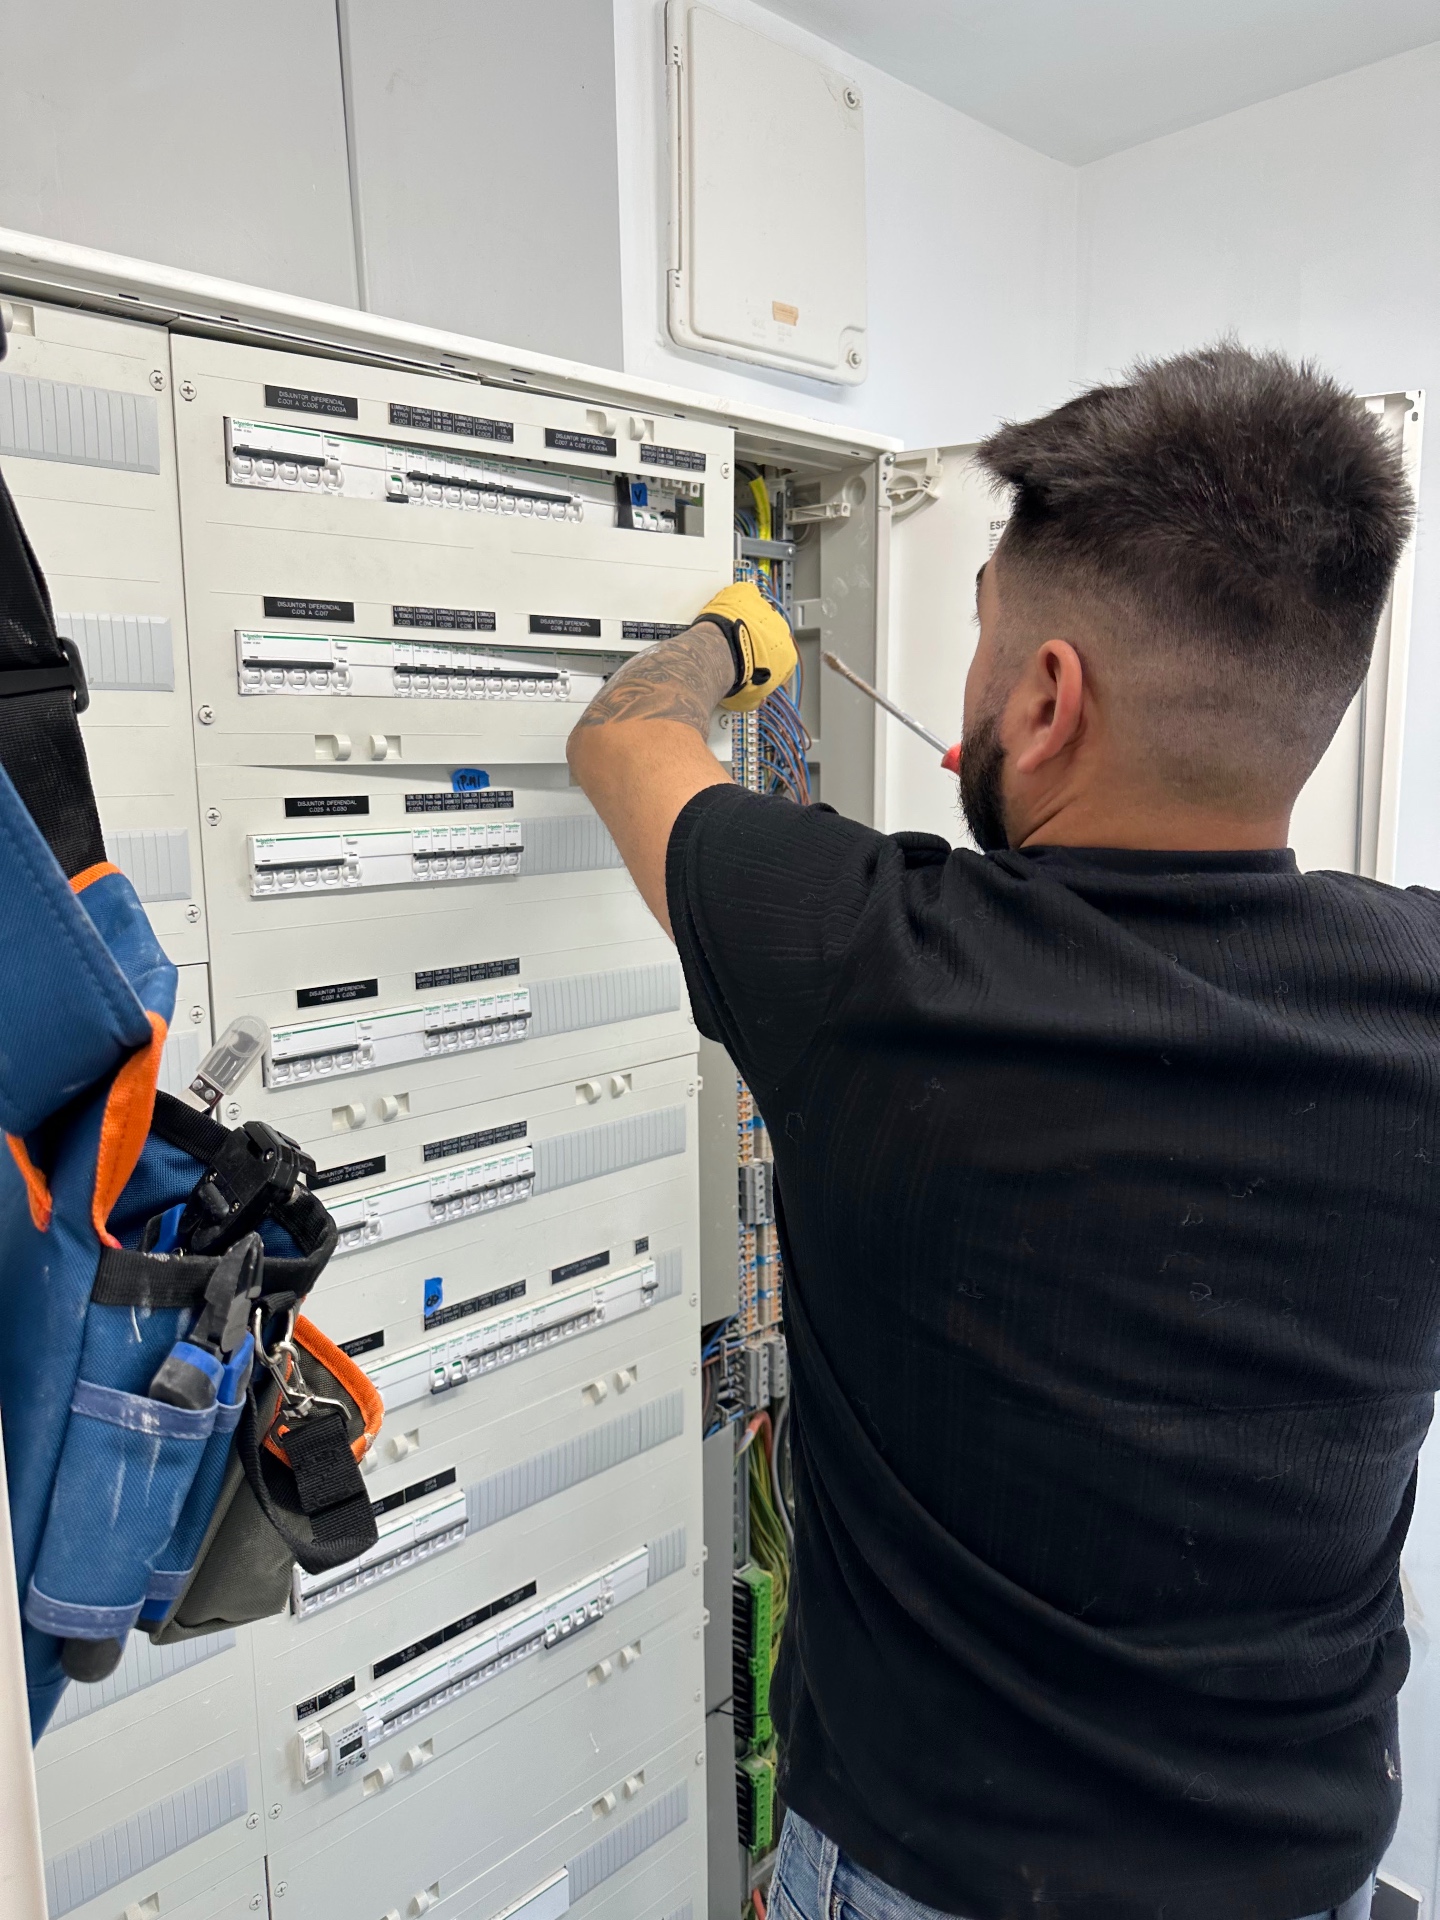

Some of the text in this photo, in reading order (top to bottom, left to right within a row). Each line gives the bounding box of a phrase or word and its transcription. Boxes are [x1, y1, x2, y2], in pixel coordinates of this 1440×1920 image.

[279, 391, 344, 406] DISJUNTOR DIFERENCIAL
[233, 420, 253, 428] Schneider
[556, 433, 579, 441] DISJUNTOR
[309, 988, 335, 997] DISJUNTOR
